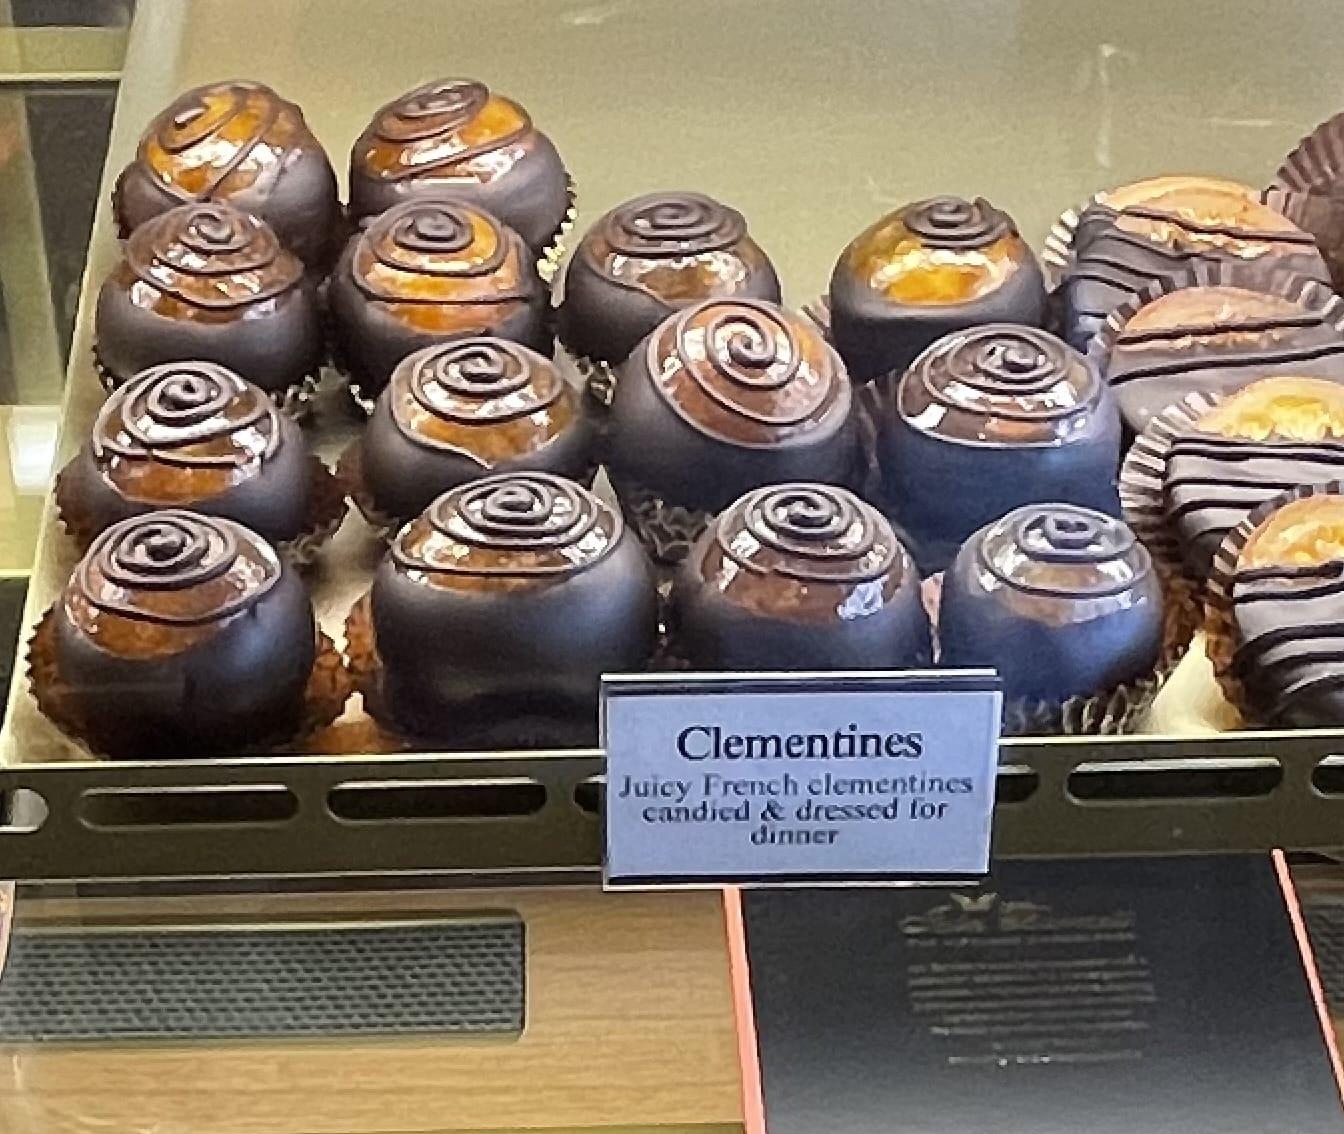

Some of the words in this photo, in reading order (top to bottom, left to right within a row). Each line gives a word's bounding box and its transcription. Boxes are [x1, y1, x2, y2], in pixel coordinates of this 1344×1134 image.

[677, 723, 923, 761] Clementines
[619, 774, 692, 803] Juicy
[704, 772, 798, 797] French
[807, 772, 974, 795] clementines
[642, 800, 750, 822] candied
[761, 801, 786, 822] &
[796, 798, 899, 822] dressed
[909, 796, 949, 820] for
[751, 825, 839, 846] dinner
